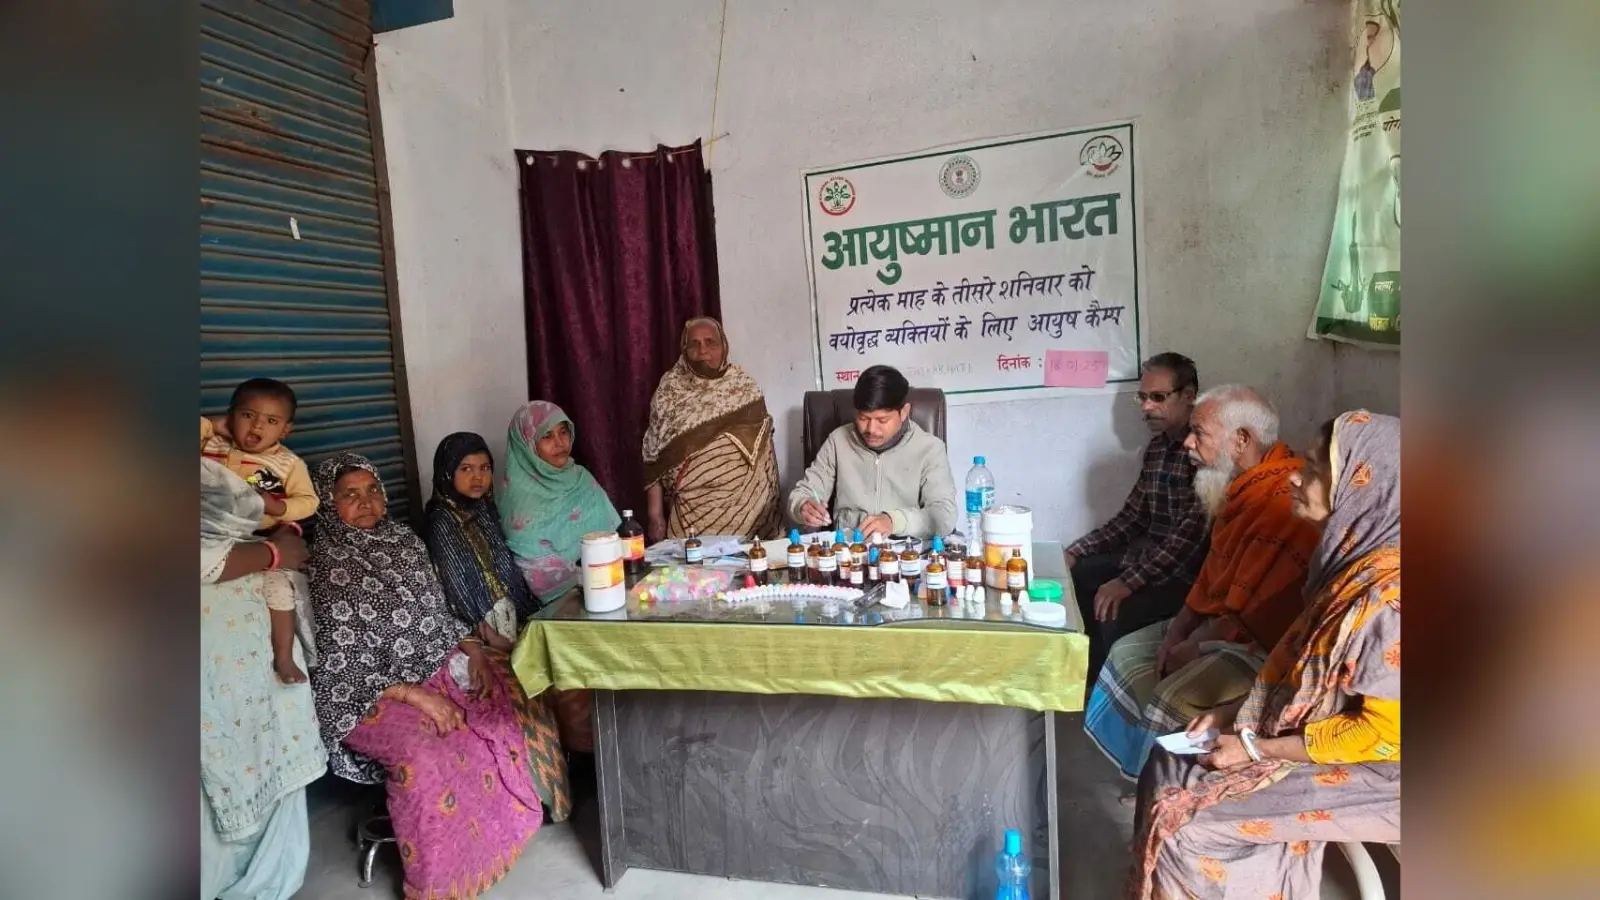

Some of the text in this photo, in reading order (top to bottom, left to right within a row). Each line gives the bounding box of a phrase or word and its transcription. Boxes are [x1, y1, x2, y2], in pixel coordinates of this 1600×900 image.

[821, 192, 1121, 286] आयुष्मान भारत
[846, 264, 1096, 316] प्रत्येक माह के तीसरे शनिवार को
[828, 300, 1126, 355] वयोवृद्ध व्यक्तियों के लिए आयुष कैम्प
[996, 354, 1032, 373] दिनांक
